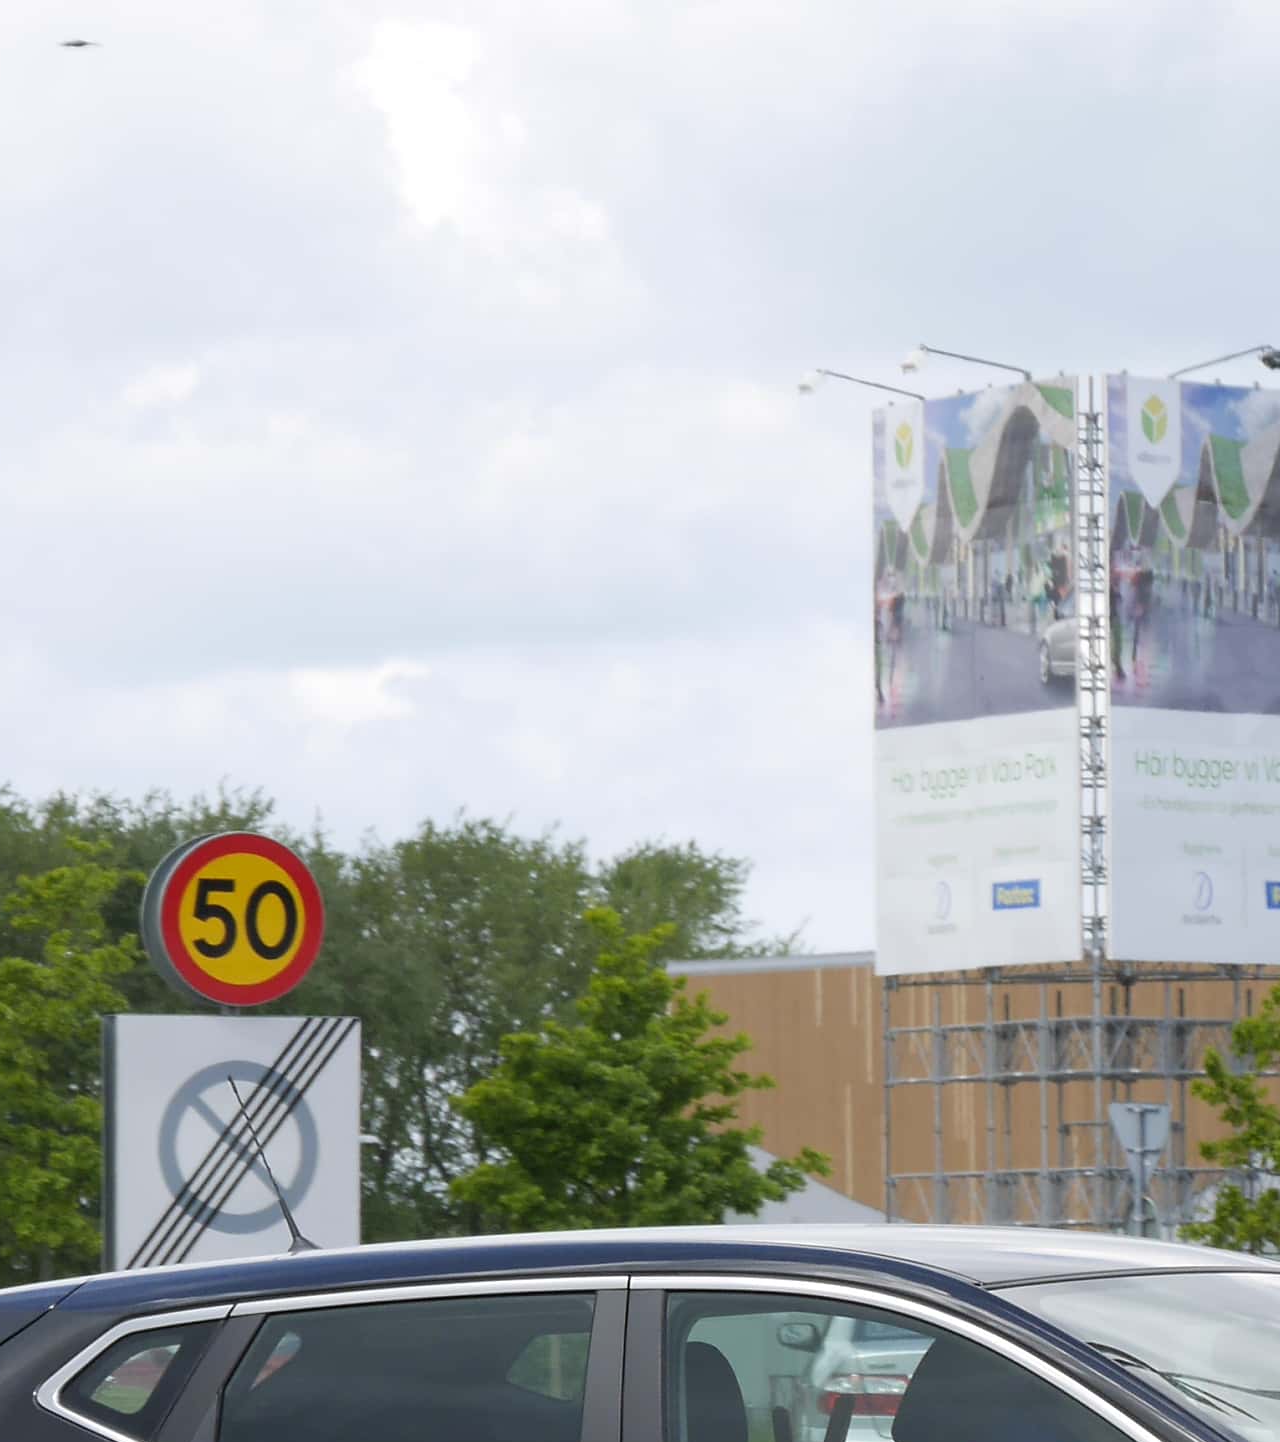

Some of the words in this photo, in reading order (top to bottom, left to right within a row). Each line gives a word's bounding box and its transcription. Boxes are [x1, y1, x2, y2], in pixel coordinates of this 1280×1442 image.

[1173, 752, 1240, 788] bygger
[1245, 757, 1259, 781] vi
[192, 878, 298, 961] 50
